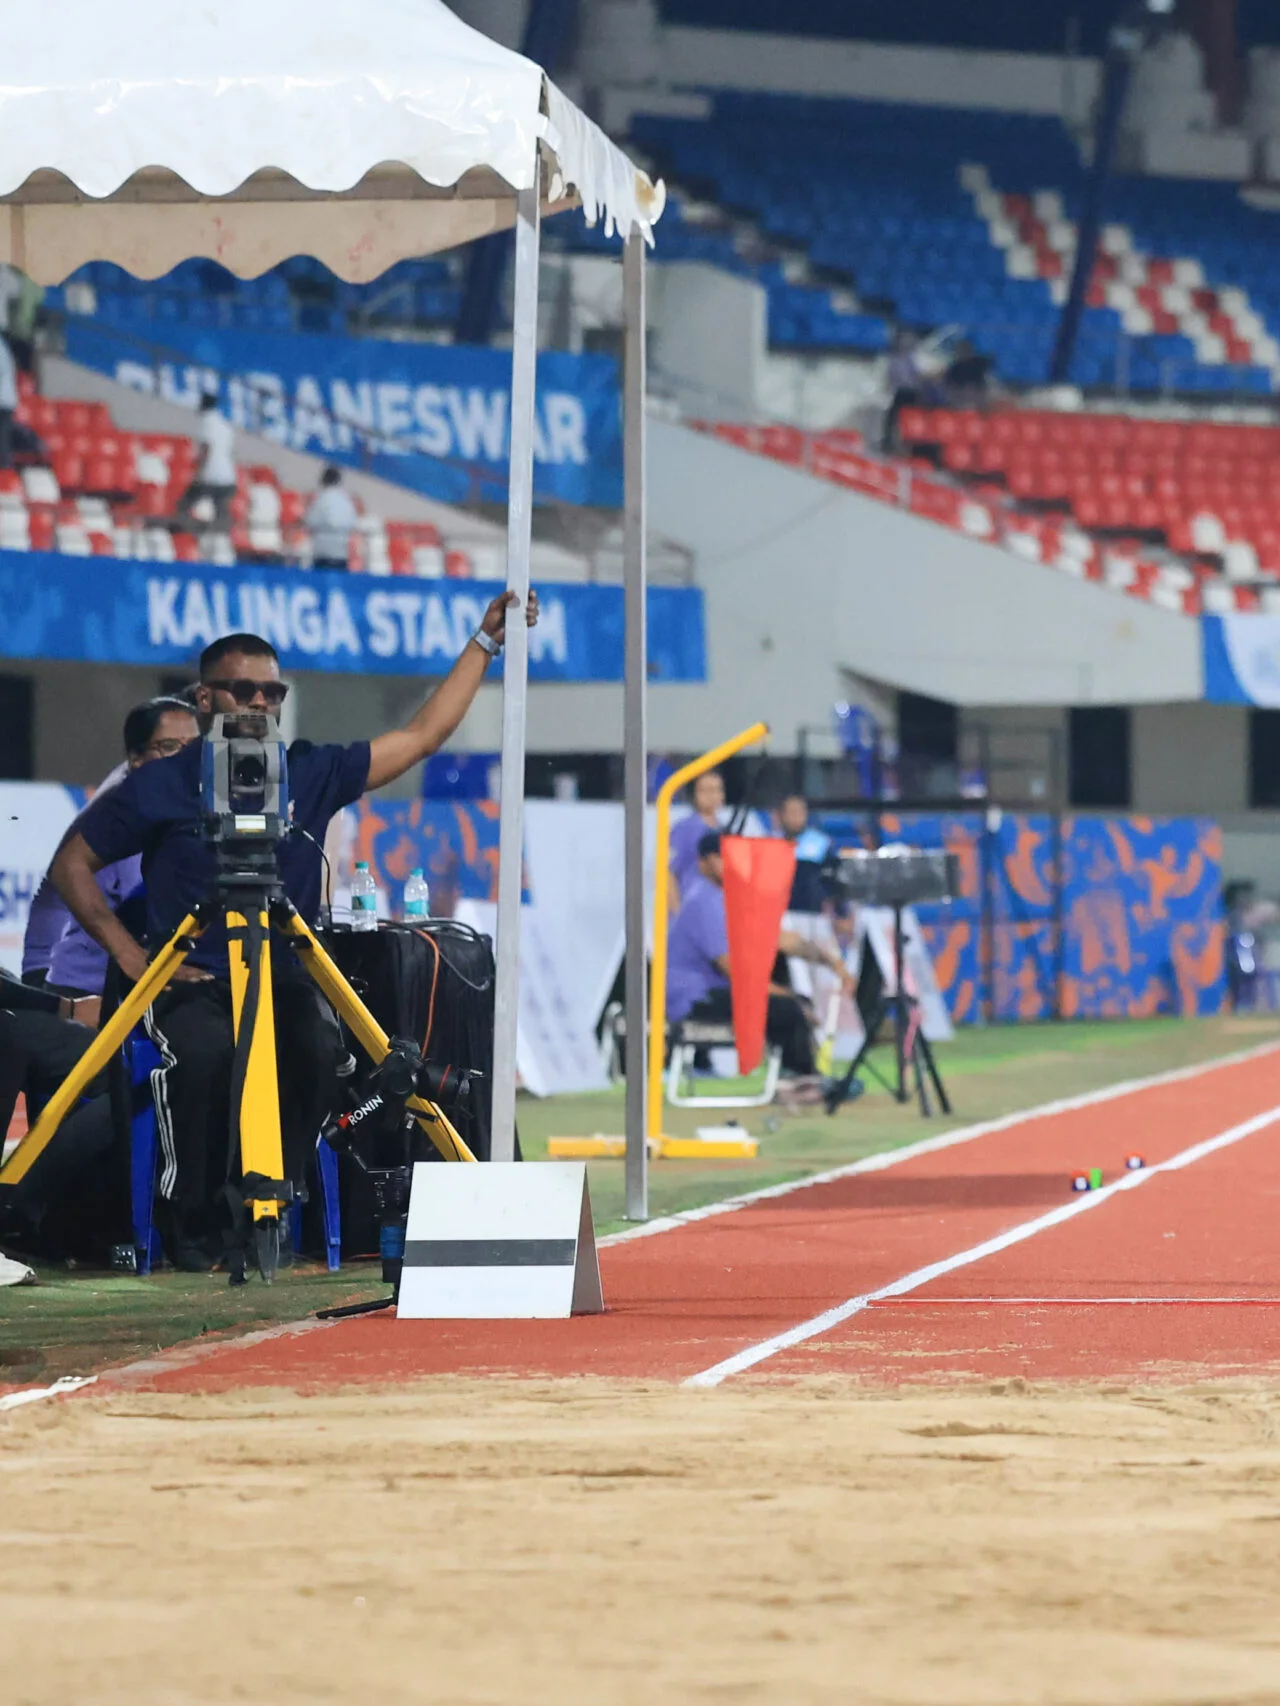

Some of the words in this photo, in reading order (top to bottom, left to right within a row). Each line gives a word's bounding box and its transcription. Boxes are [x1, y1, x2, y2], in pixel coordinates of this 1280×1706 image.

[146, 577, 361, 657] KALINGA
[369, 591, 568, 664] STADM
[348, 1094, 384, 1126] RONIN
